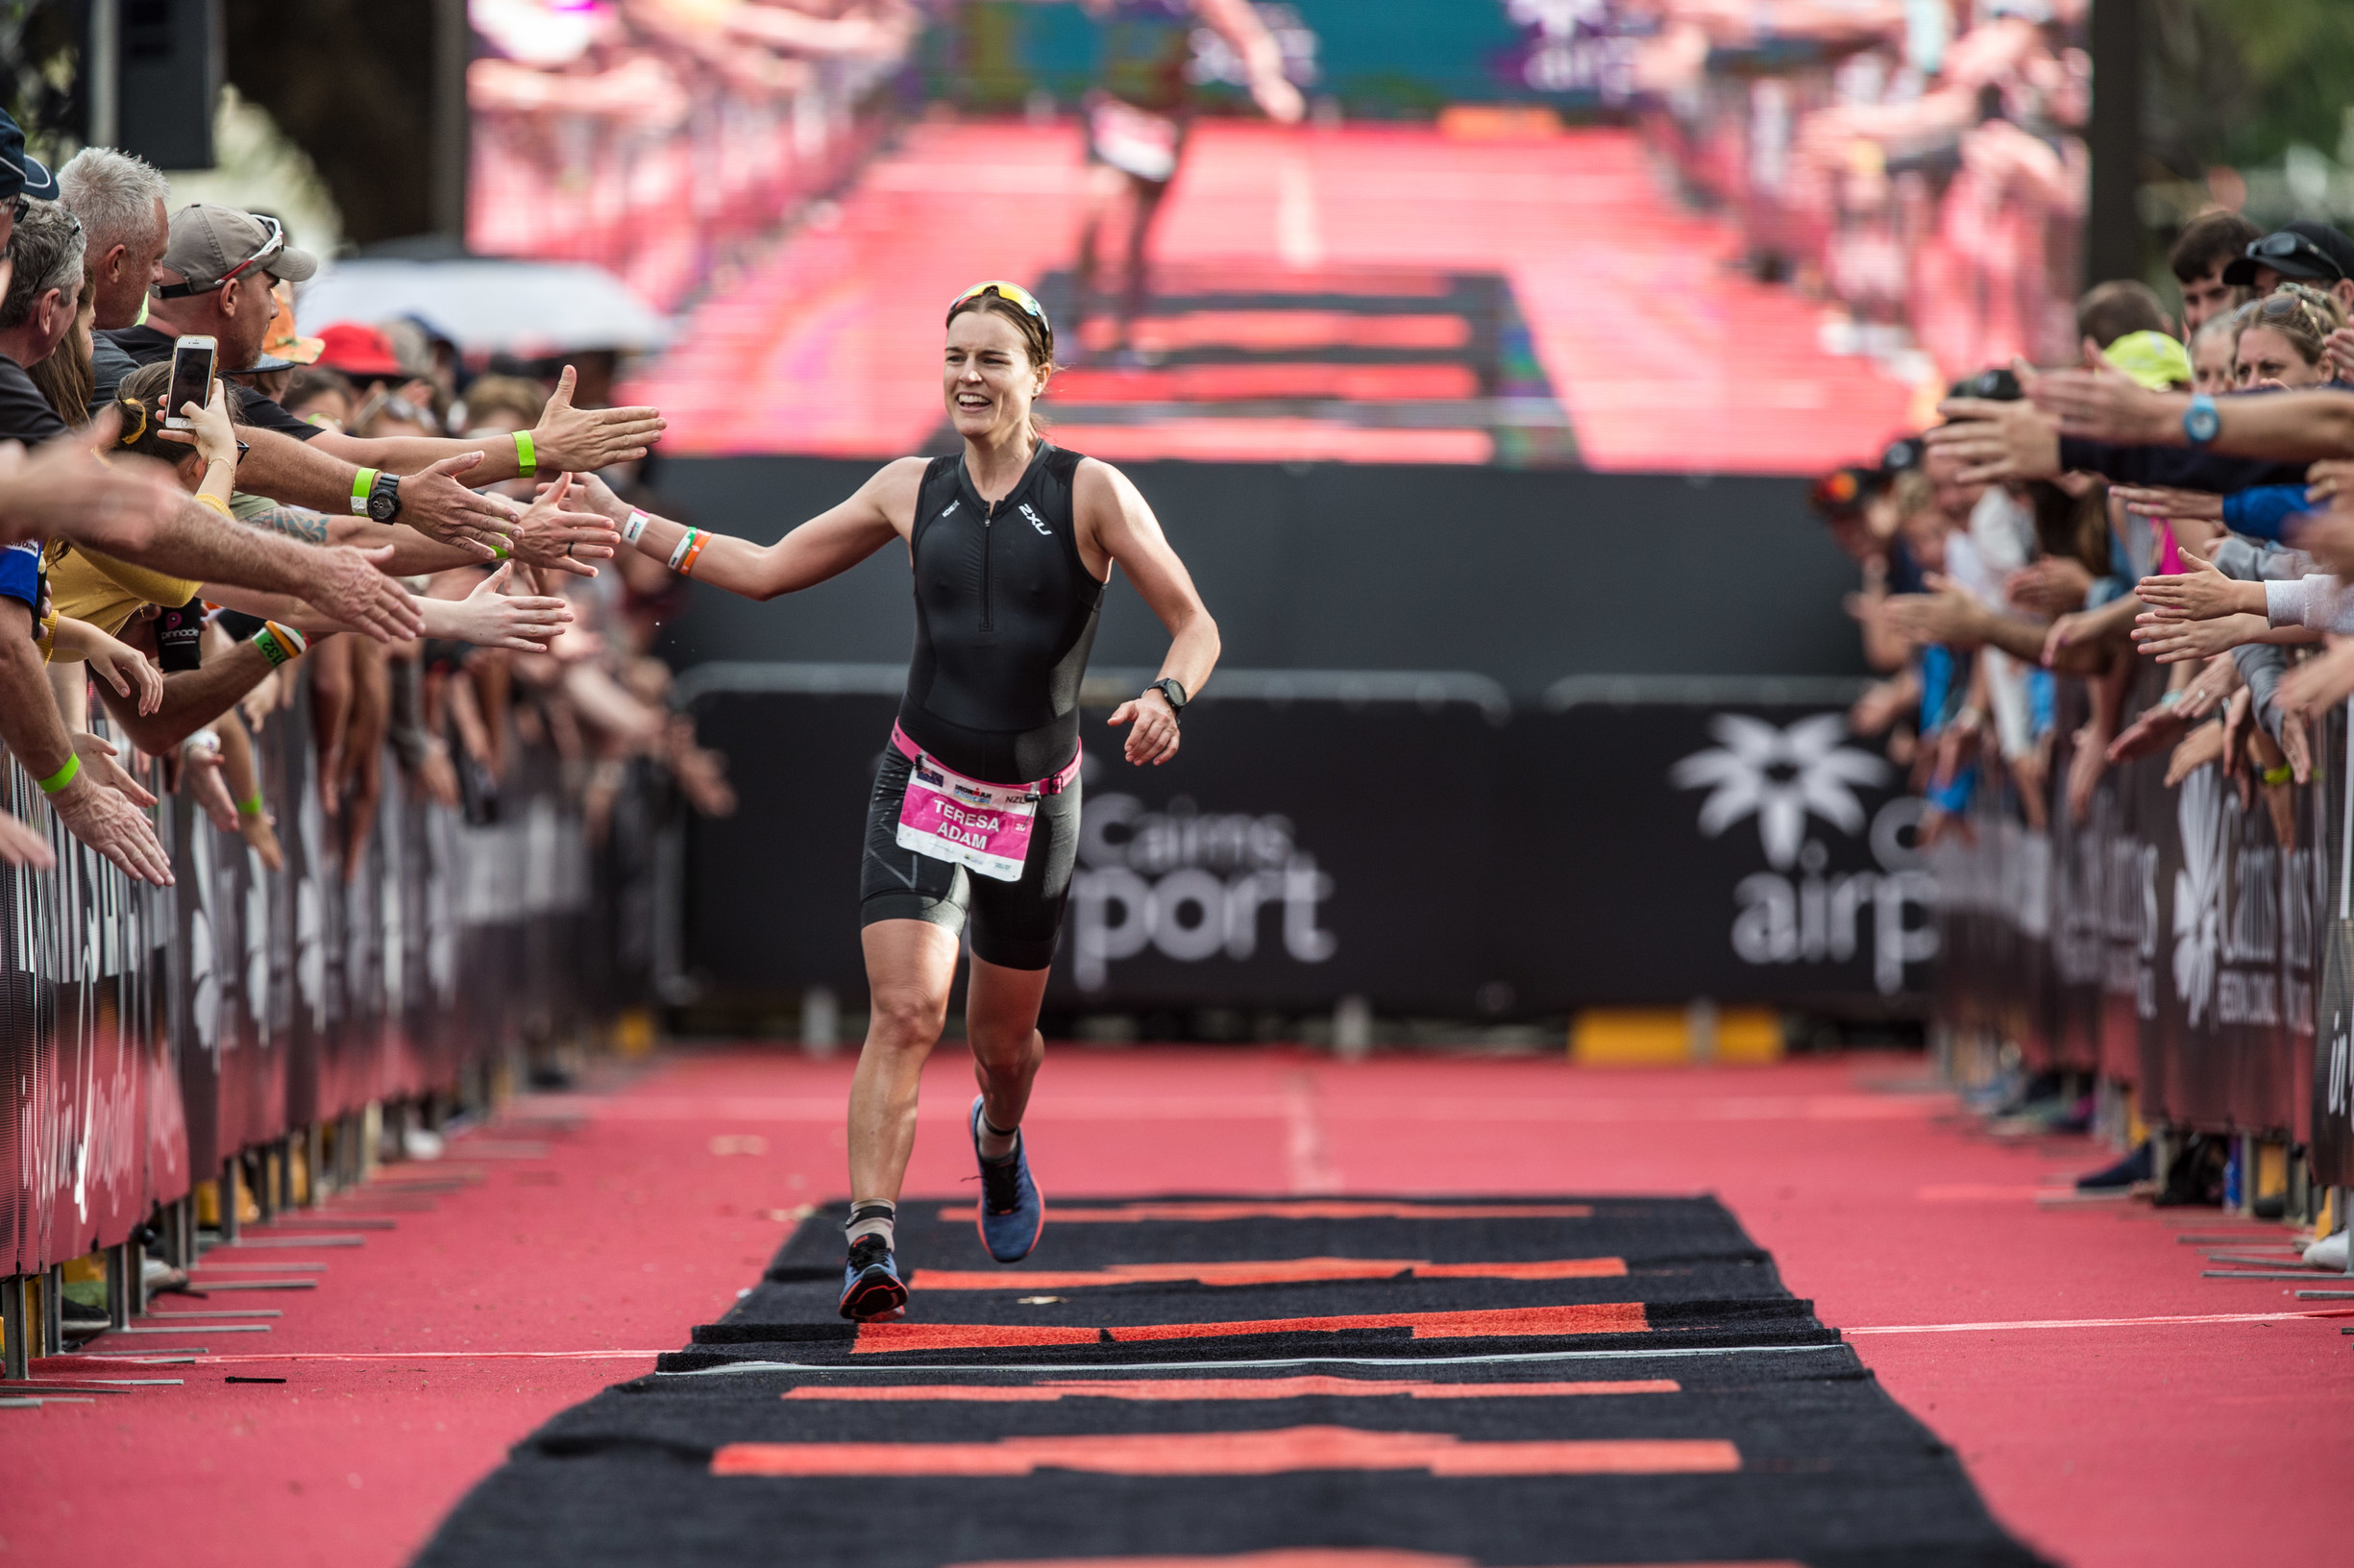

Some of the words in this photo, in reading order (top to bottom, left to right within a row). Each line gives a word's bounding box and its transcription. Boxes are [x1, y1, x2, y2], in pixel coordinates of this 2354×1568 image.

[1018, 502, 1052, 536] 2XU
[934, 799, 1000, 833] TERESA
[1005, 796, 1026, 804] NZL
[937, 821, 988, 850] ADAM
[1071, 851, 1337, 993] port
[1731, 838, 1941, 995] airp
